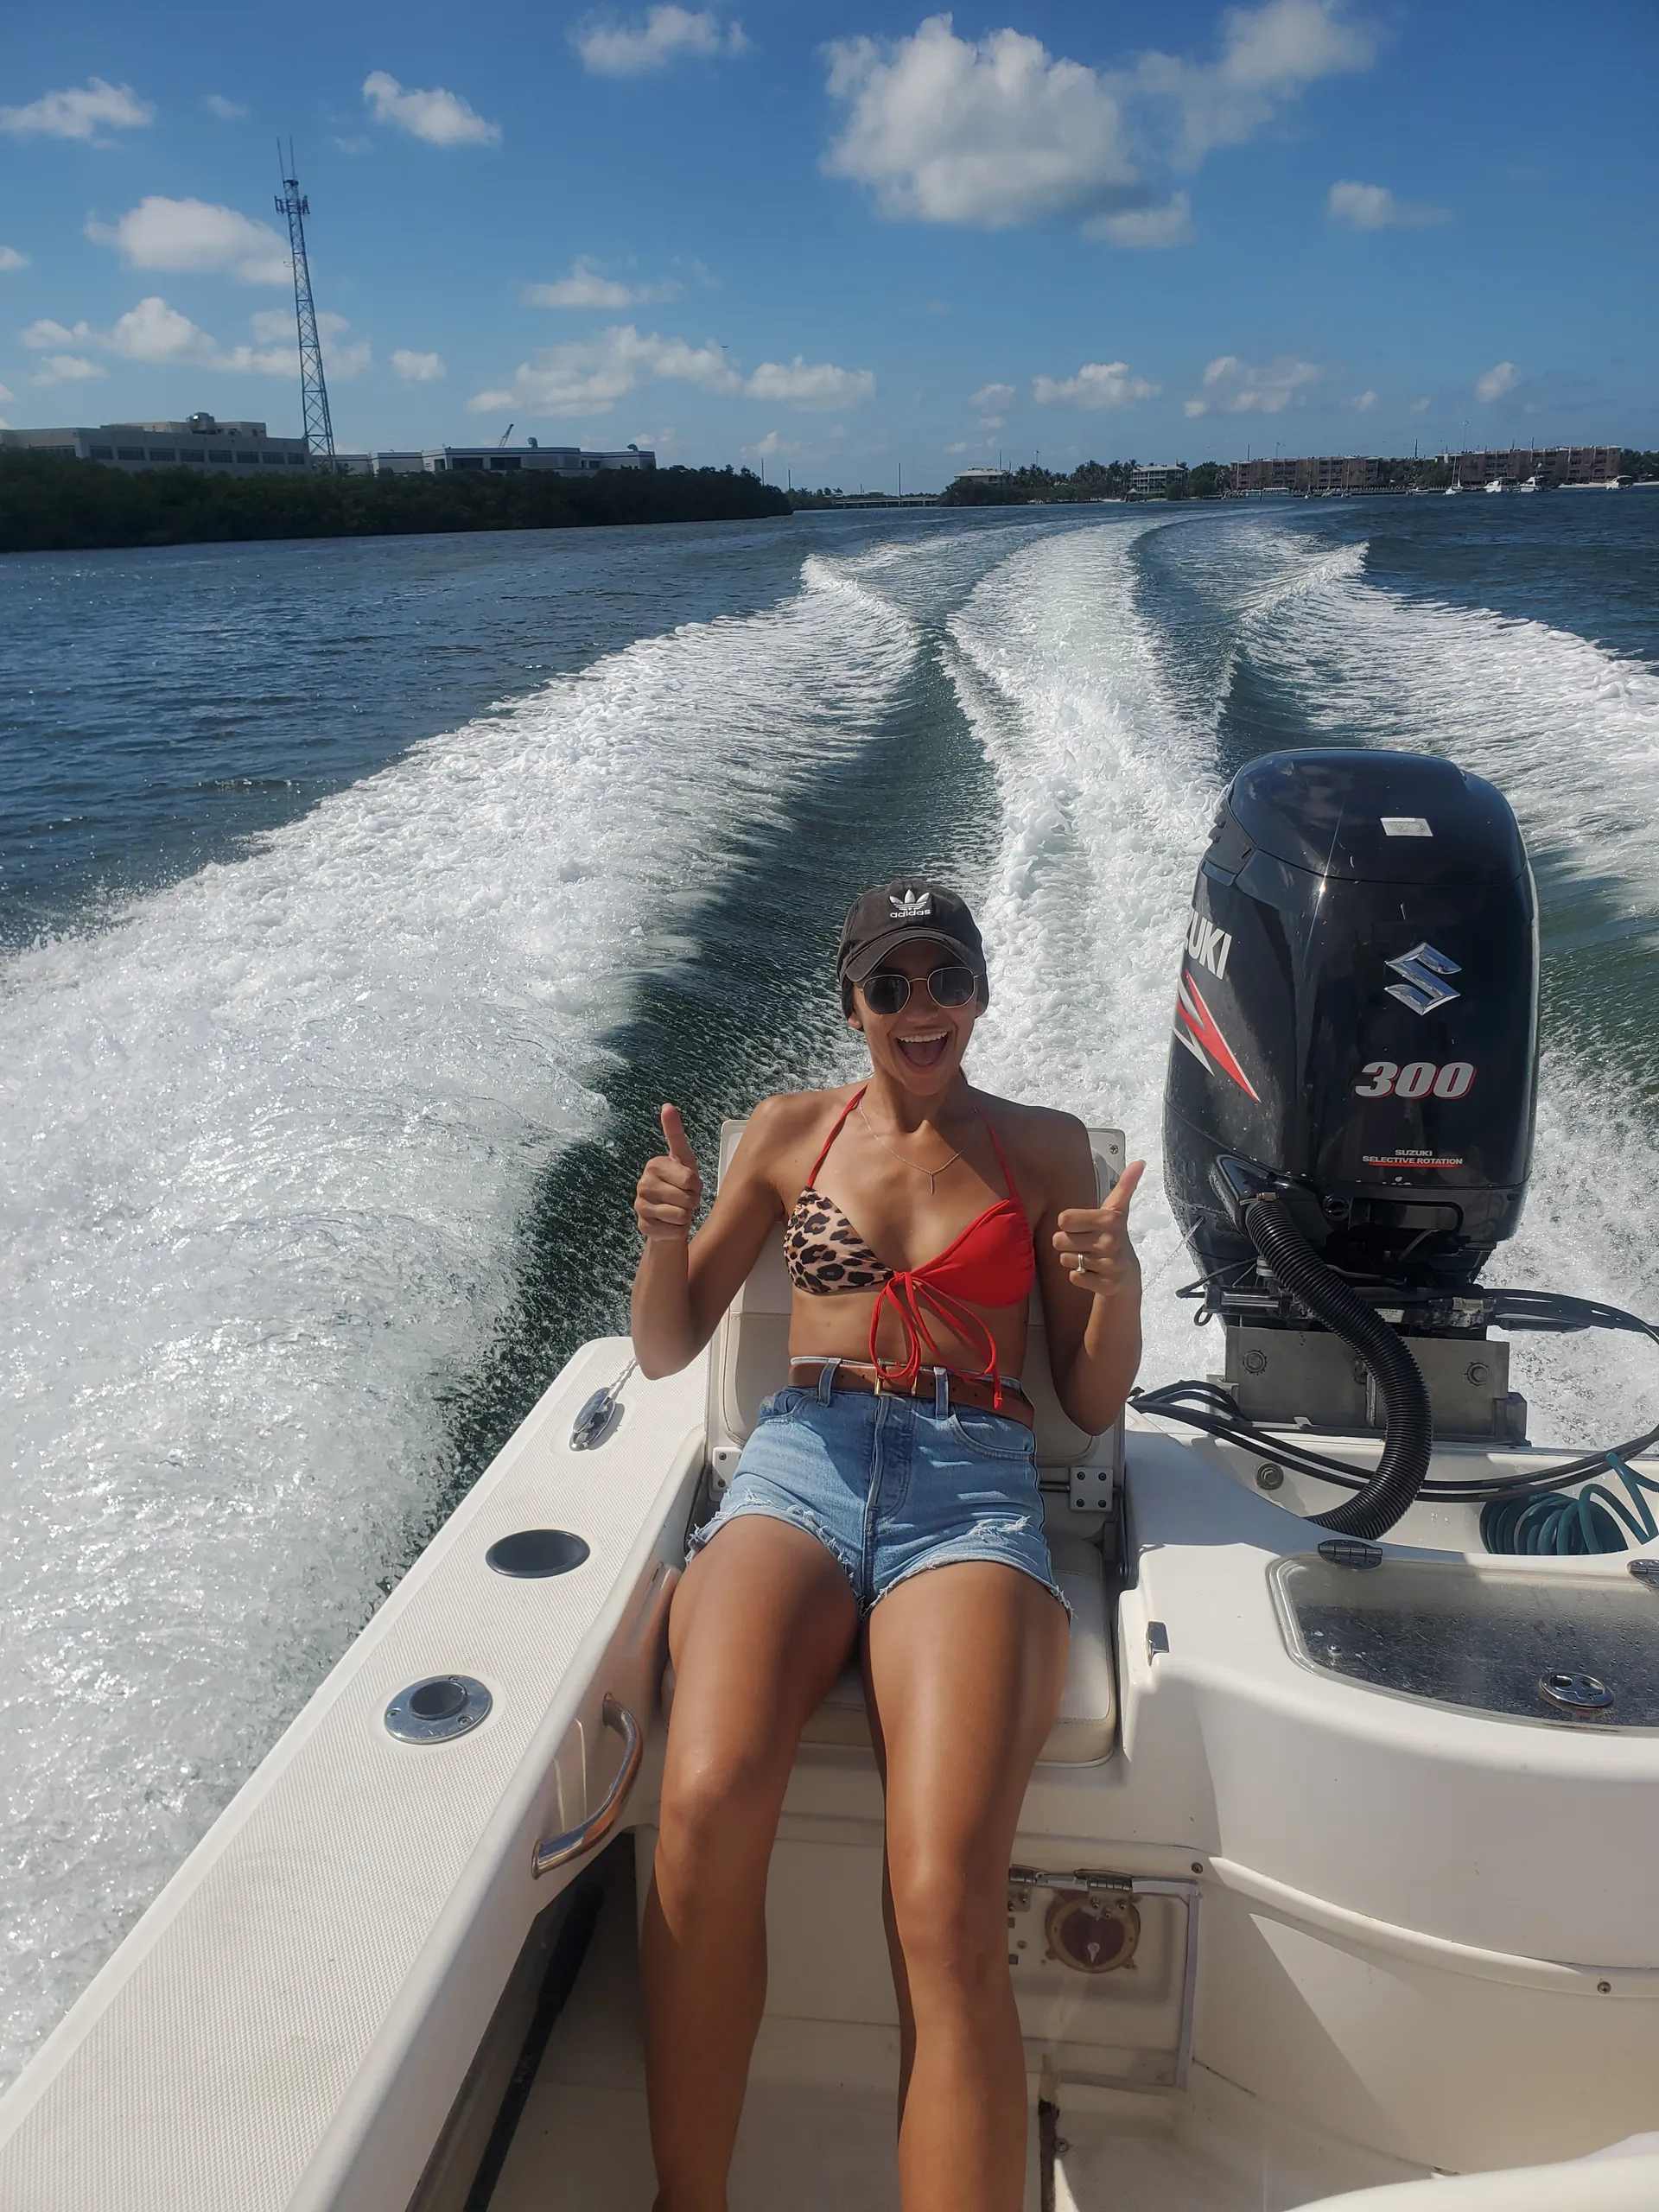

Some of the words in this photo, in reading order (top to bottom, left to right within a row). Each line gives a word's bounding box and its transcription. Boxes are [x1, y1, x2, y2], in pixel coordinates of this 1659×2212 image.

[890, 909, 931, 918] adidas
[1186, 909, 1232, 980] UKI
[1355, 1061, 1478, 1099] 300
[1362, 1155, 1415, 1164] SELECTIVE
